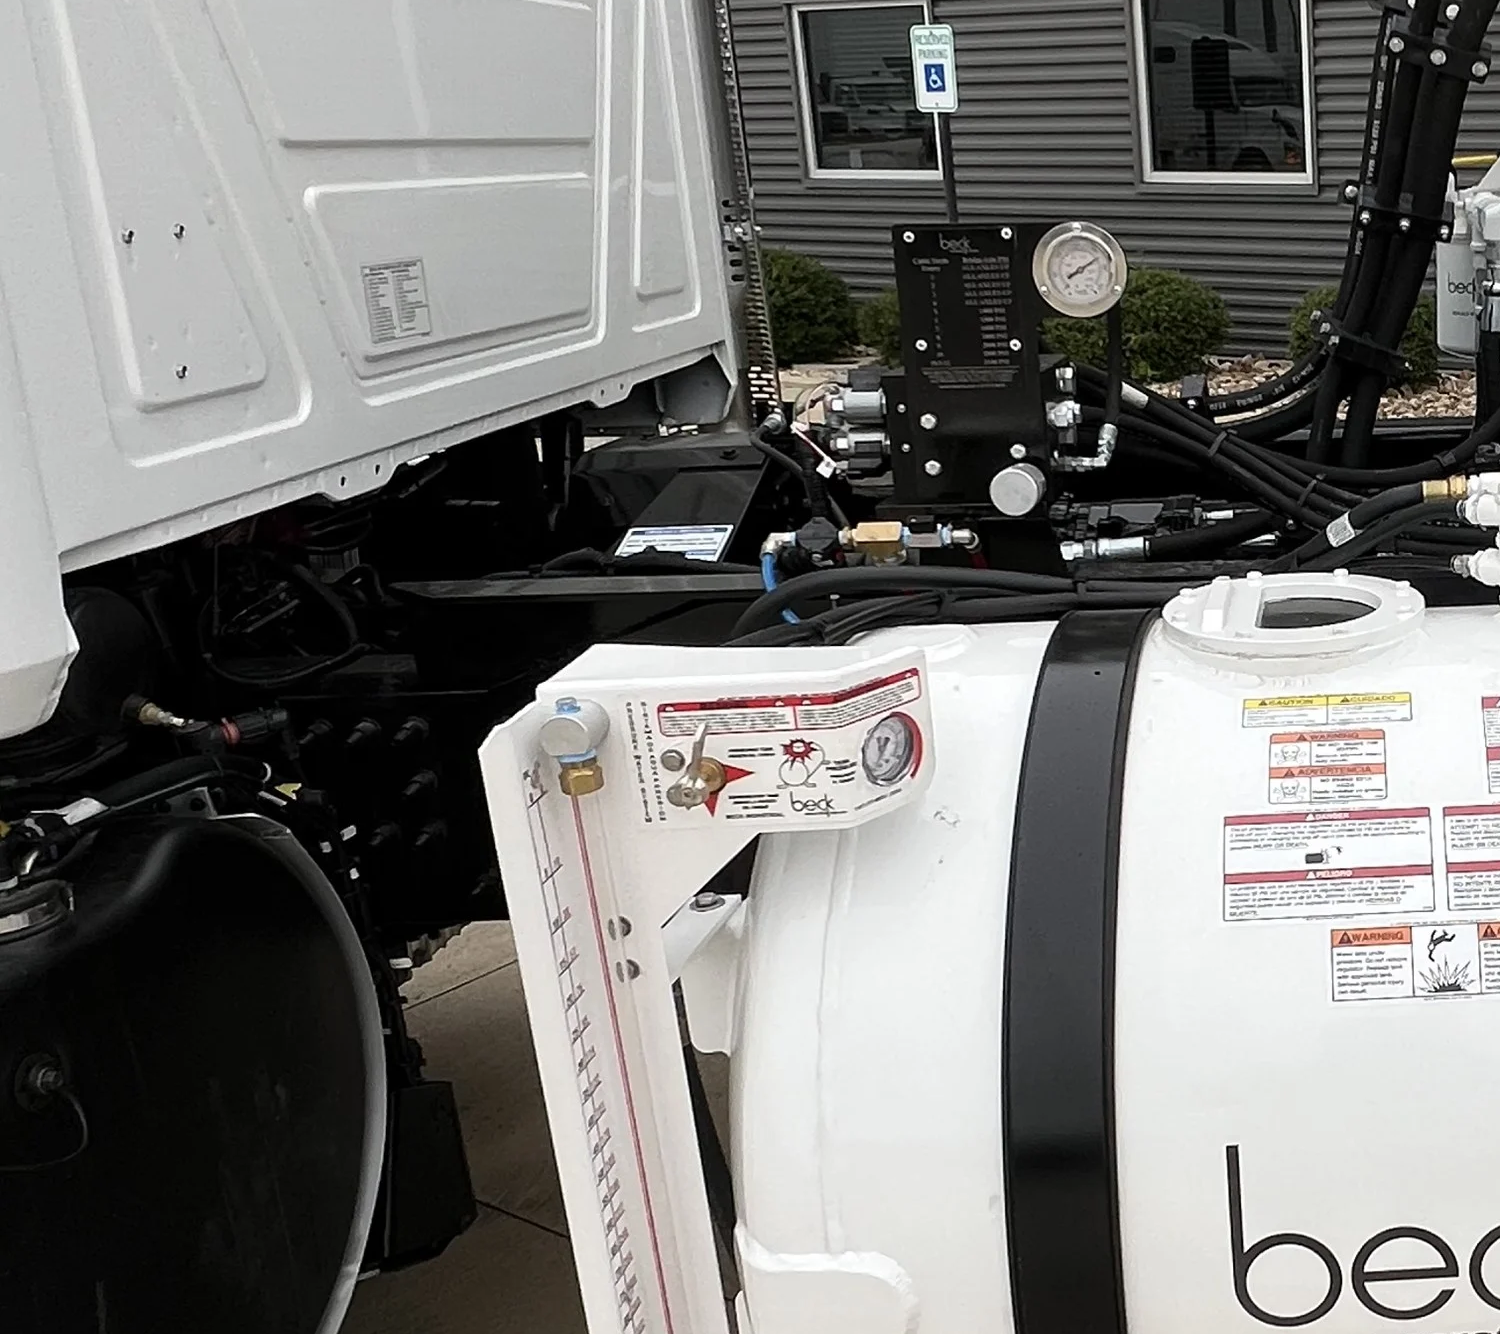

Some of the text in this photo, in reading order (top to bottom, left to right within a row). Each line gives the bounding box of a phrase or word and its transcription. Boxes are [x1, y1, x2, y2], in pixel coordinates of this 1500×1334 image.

[1298, 766, 1372, 776] ADVERTENCIA
[790, 791, 835, 817] beck
[1352, 932, 1404, 942] WARNING
